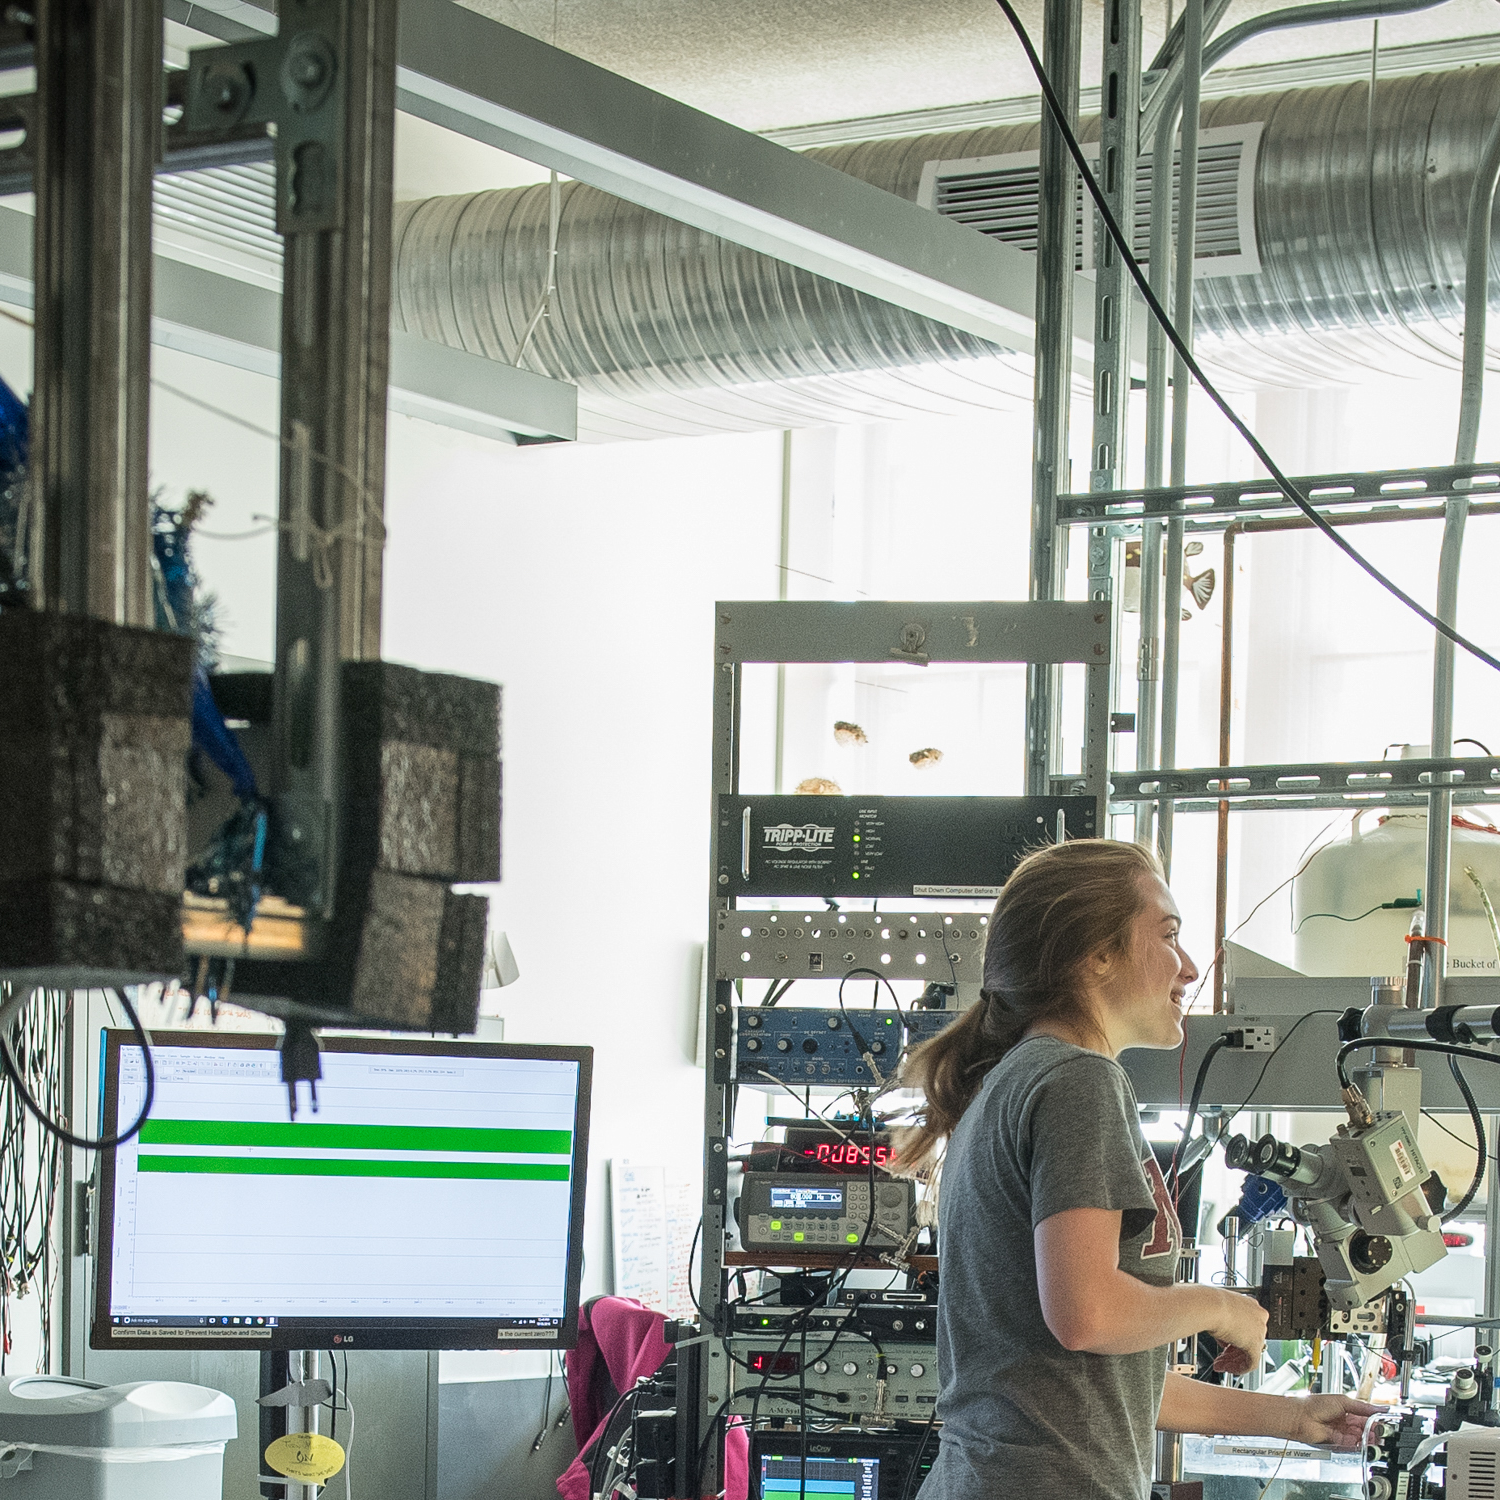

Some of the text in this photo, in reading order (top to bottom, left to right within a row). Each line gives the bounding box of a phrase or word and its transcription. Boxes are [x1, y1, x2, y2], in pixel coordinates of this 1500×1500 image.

[1452, 959, 1485, 969] Bucket
[1486, 959, 1497, 969] of
[112, 1328, 136, 1336] Confirm
[809, 1444, 832, 1453] LeCroy
[1232, 1447, 1267, 1456] Rectangular
